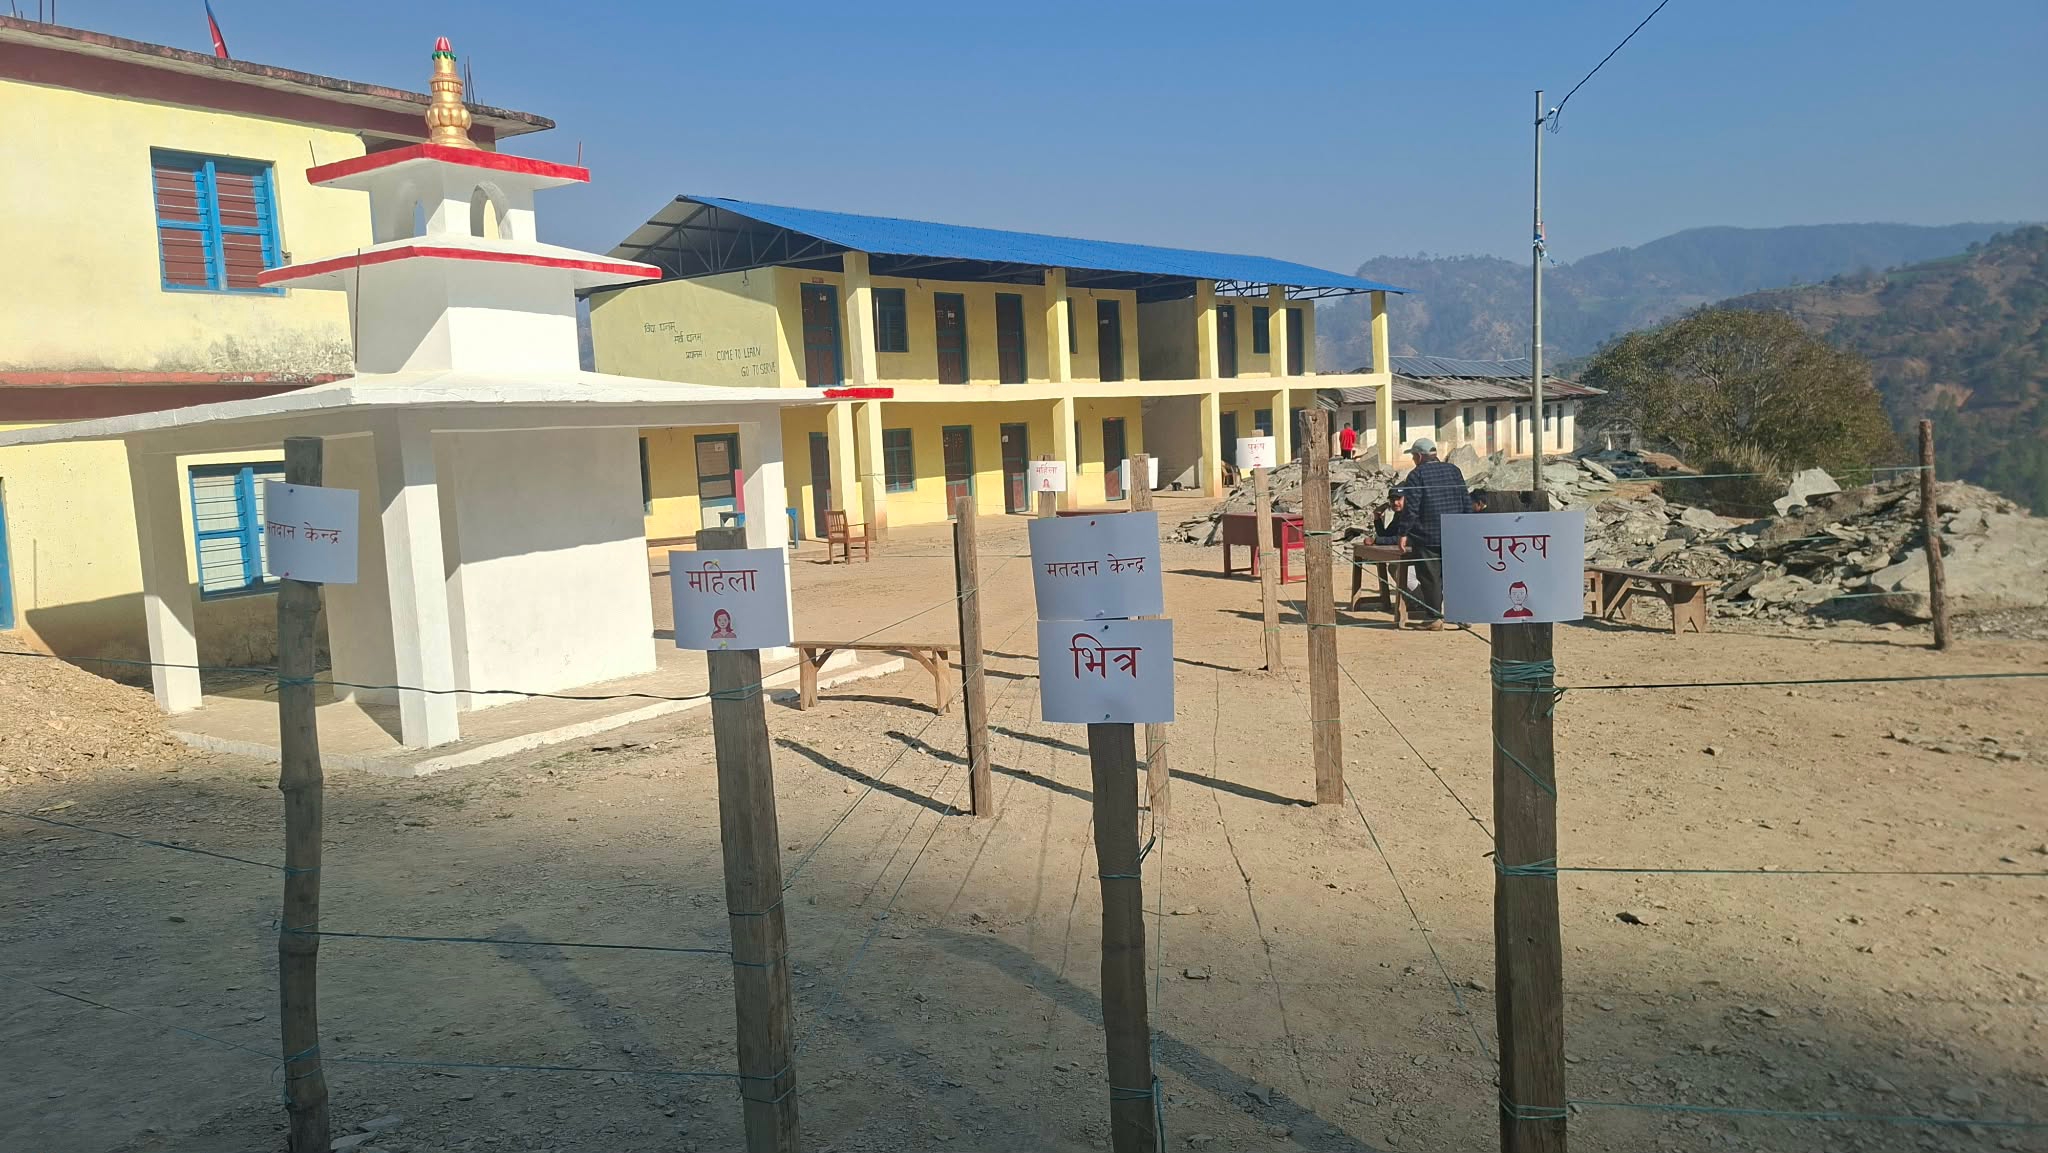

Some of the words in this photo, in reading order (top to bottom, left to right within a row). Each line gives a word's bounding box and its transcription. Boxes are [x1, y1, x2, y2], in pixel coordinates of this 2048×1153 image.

[716, 349, 733, 361] COME
[734, 348, 742, 360] TO
[743, 346, 761, 358] LEARN
[740, 366, 750, 377] GO
[752, 364, 760, 376] TO
[760, 361, 776, 375] SERVE
[1035, 463, 1058, 475] महिला
[303, 521, 342, 544] केन्द्र
[1483, 534, 1551, 571] पुरुष
[1044, 560, 1099, 577] मतदान
[1107, 553, 1146, 574] केन्द्र
[685, 560, 758, 595] महिला
[1068, 633, 1143, 680] भित्र
